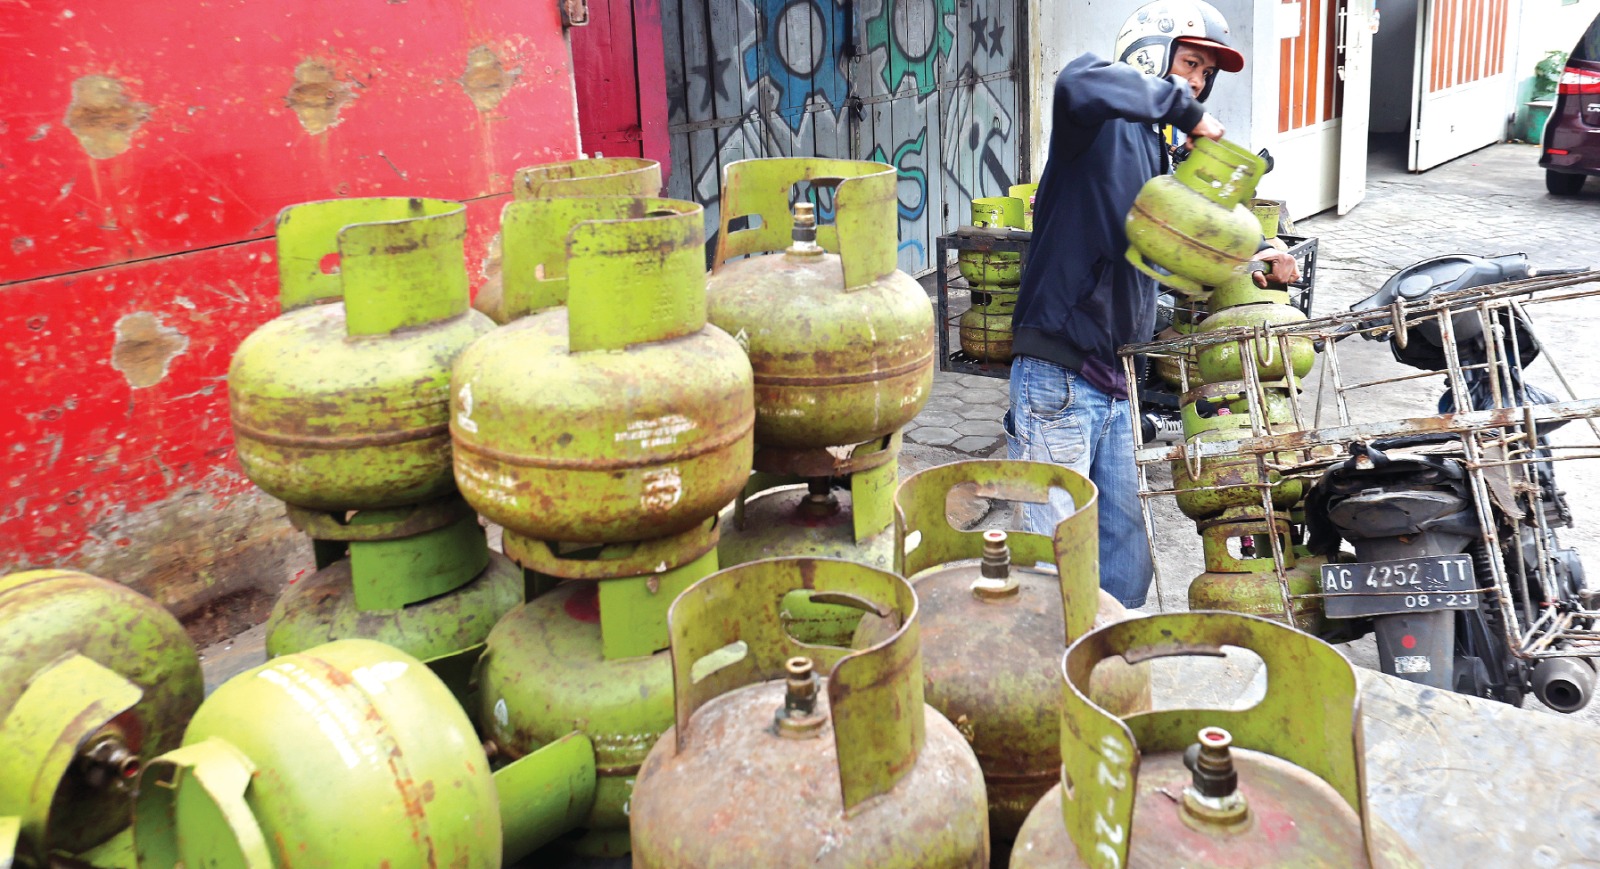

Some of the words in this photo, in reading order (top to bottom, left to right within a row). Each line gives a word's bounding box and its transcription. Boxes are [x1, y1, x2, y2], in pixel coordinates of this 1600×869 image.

[1326, 568, 1353, 591] AG
[1366, 563, 1422, 589] 4252
[1438, 560, 1467, 582] TT
